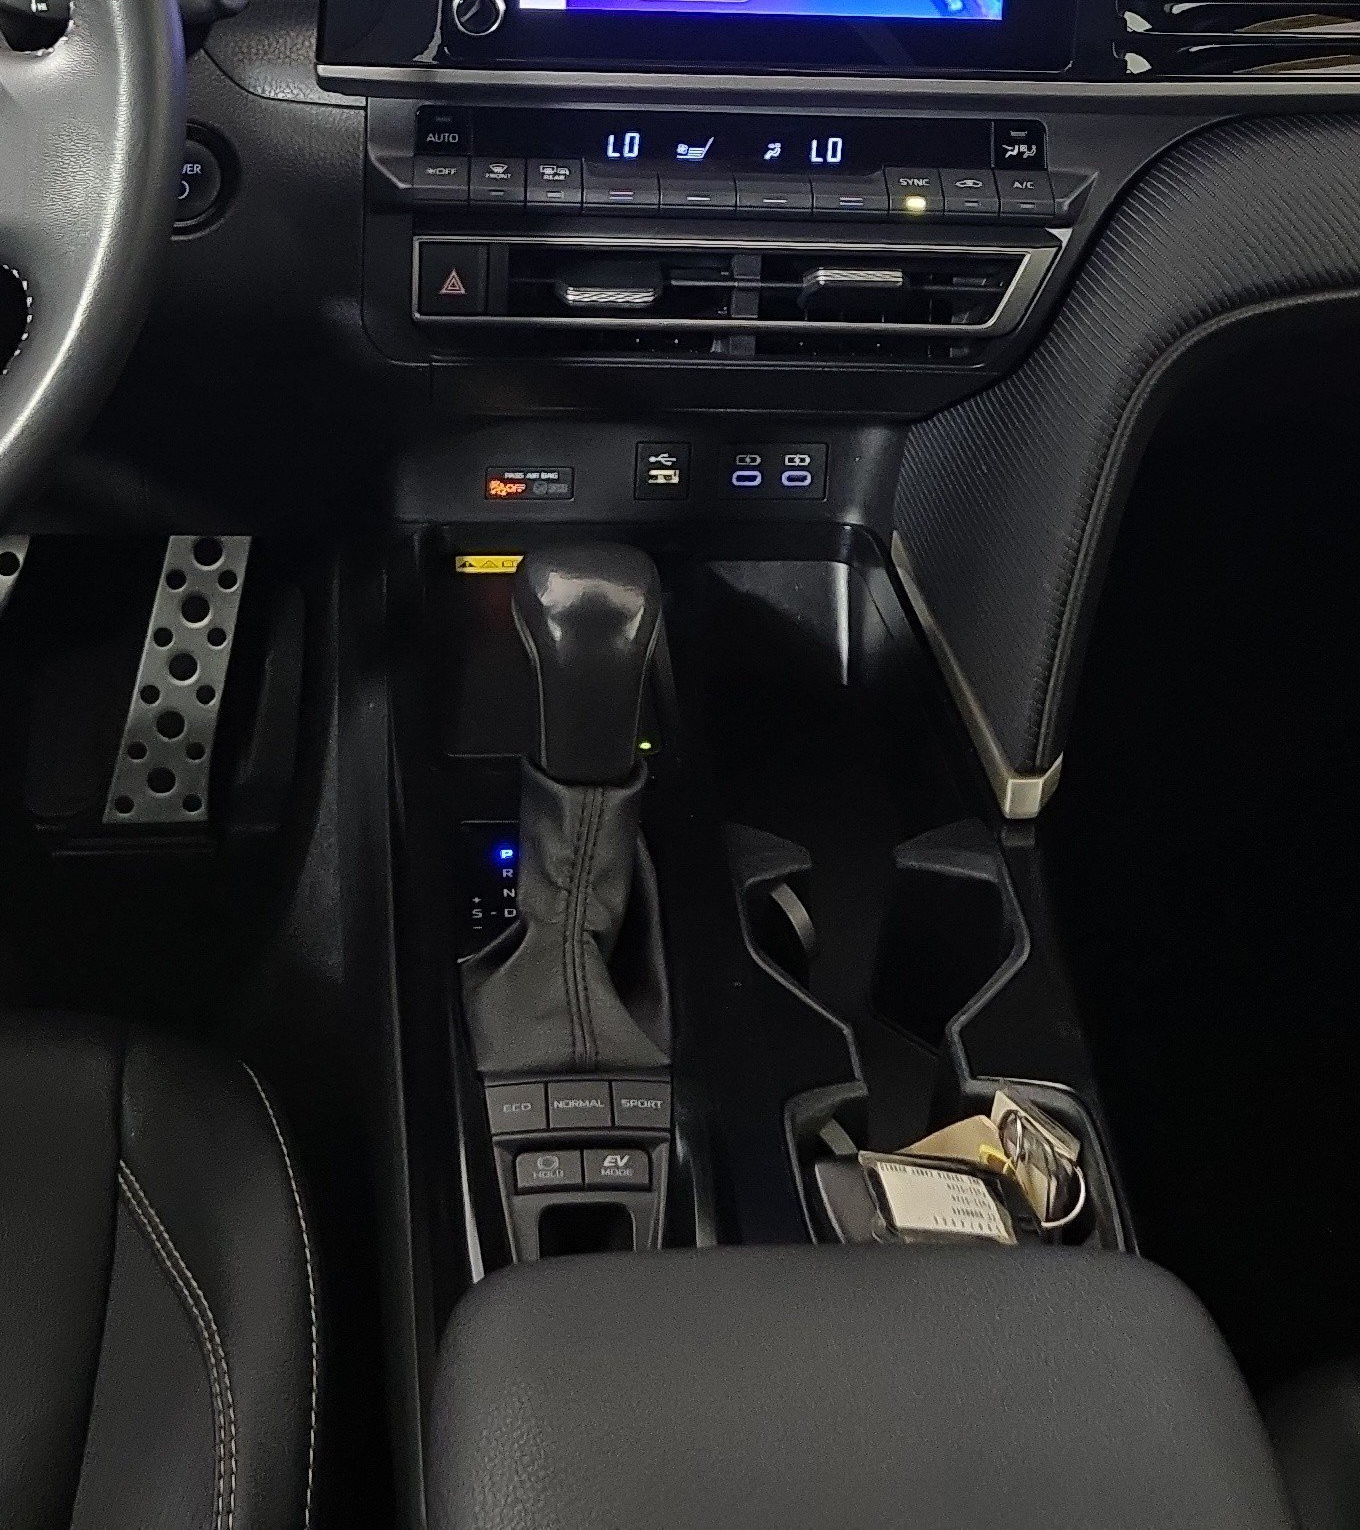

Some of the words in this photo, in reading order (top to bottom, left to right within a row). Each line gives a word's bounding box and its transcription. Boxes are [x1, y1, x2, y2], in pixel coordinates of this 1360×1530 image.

[426, 132, 459, 143] AUTO
[607, 132, 640, 158] LO
[810, 137, 843, 163] LO
[436, 167, 457, 175] OFF
[899, 178, 931, 187] SYNC
[1013, 181, 1035, 189] A/C
[500, 849, 514, 859] P
[502, 868, 514, 878] R
[503, 888, 516, 898] N
[471, 908, 483, 918] S
[504, 908, 517, 918] D
[502, 1102, 532, 1113] ECO
[553, 1099, 605, 1109] NORMAL
[620, 1098, 664, 1109] SPORT
[603, 1154, 630, 1167] EV
